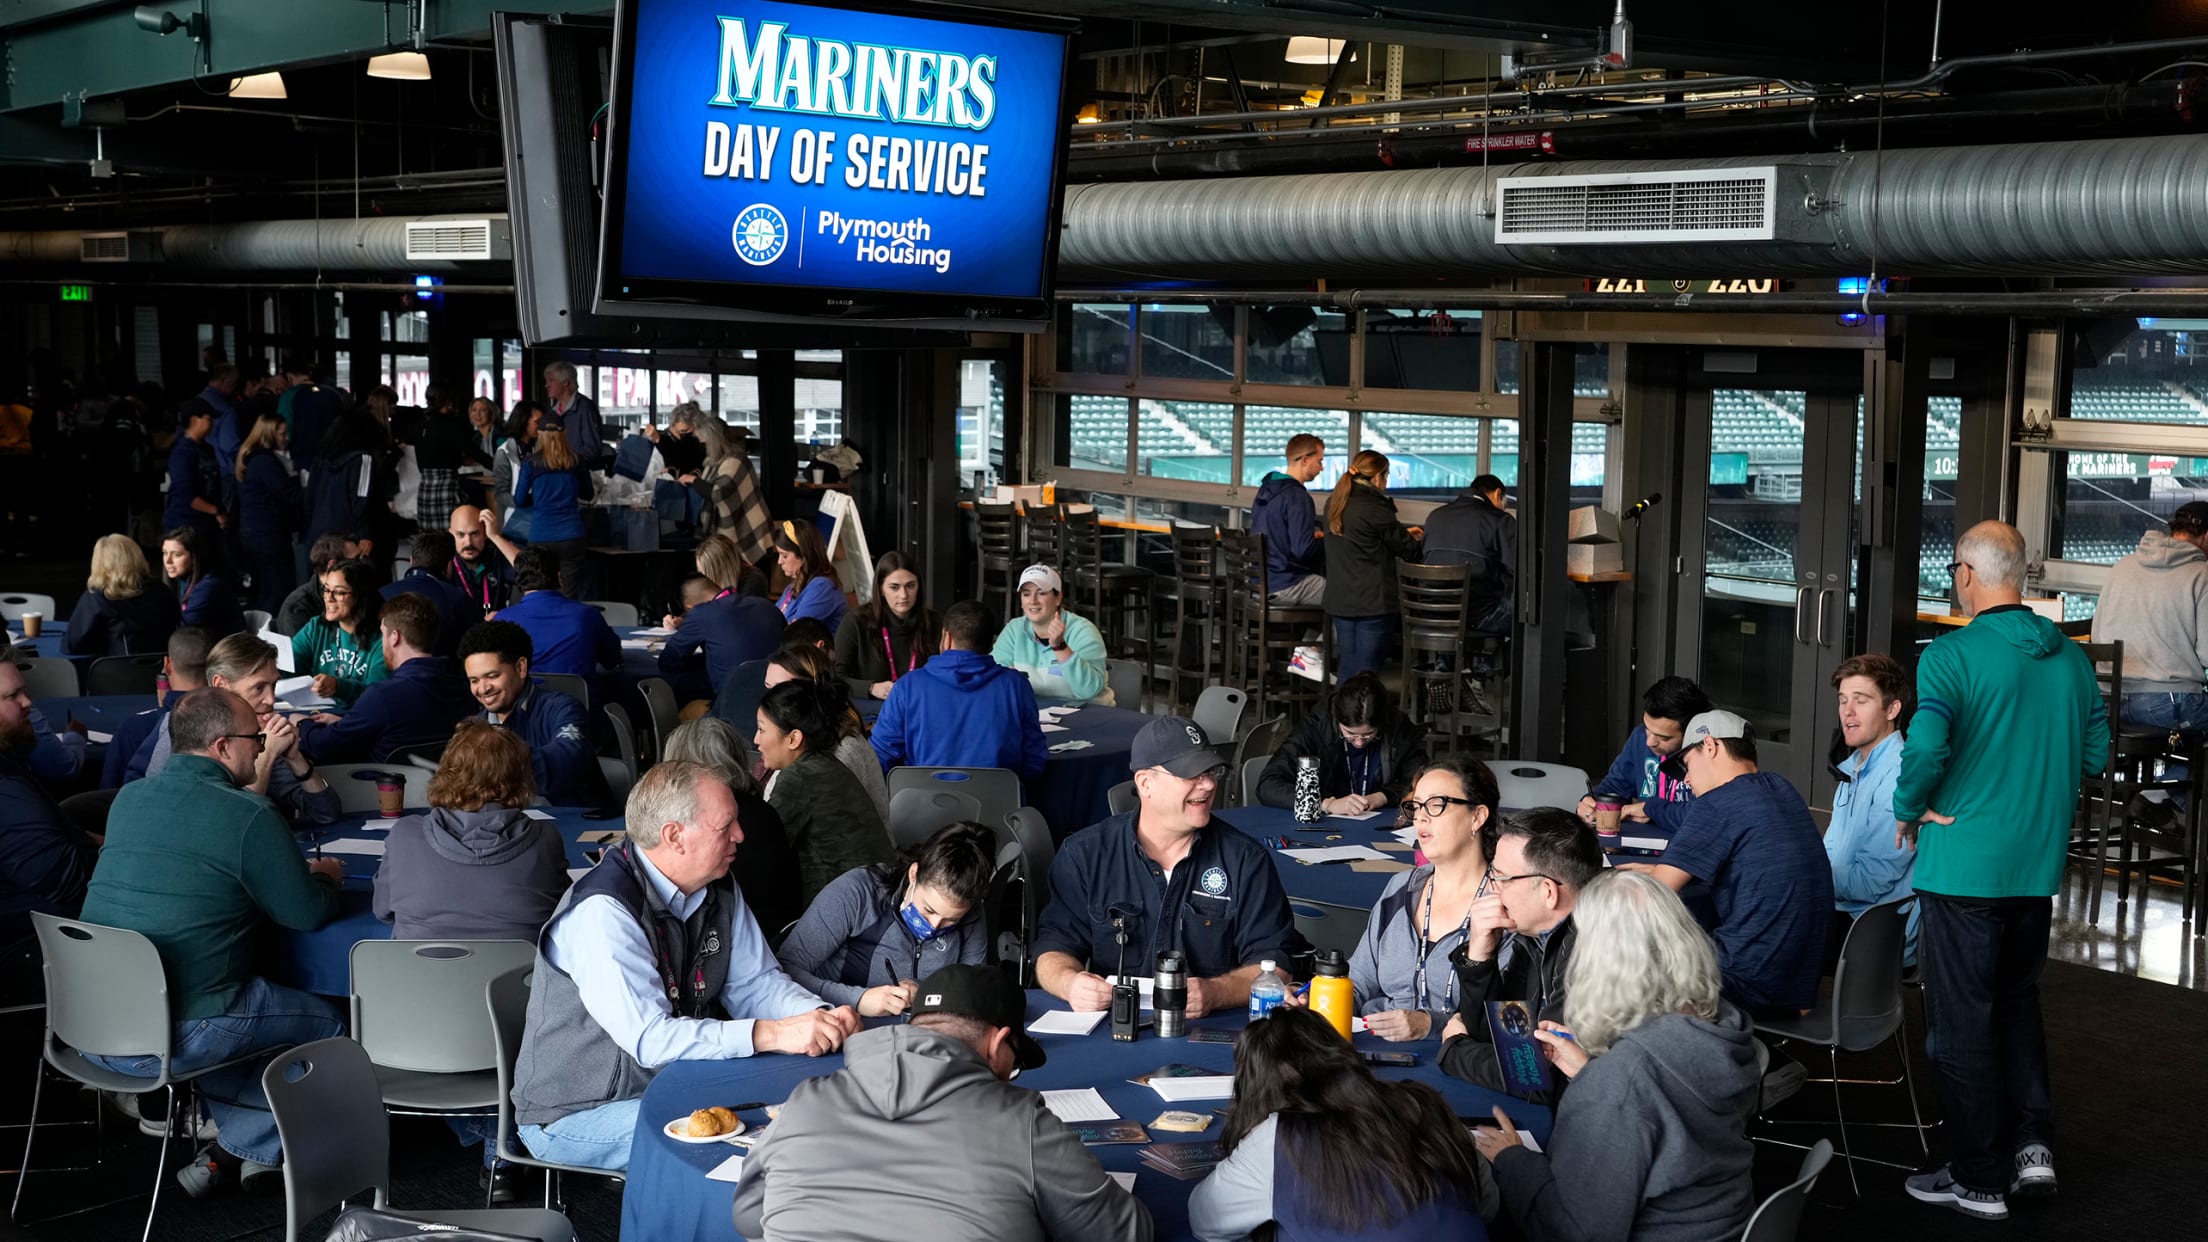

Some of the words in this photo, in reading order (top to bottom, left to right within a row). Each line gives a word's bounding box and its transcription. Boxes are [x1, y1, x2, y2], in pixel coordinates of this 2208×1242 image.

[708, 15, 998, 131] MARINERS
[1467, 138, 1481, 149] FIRE
[1481, 136, 1514, 148] SRINKLER
[1514, 134, 1536, 146] WATER
[704, 121, 781, 180] DAY
[790, 128, 836, 185] OF
[845, 133, 990, 197] SERVICE
[818, 211, 931, 244] Plymouth
[856, 237, 951, 273] Housing
[617, 368, 689, 407] PARK
[1934, 457, 1959, 475] 10:
[2068, 453, 2093, 465] HOME
[2096, 454, 2108, 464] OF
[2111, 453, 2128, 465] THE
[2081, 462, 2137, 476] MARINERS
